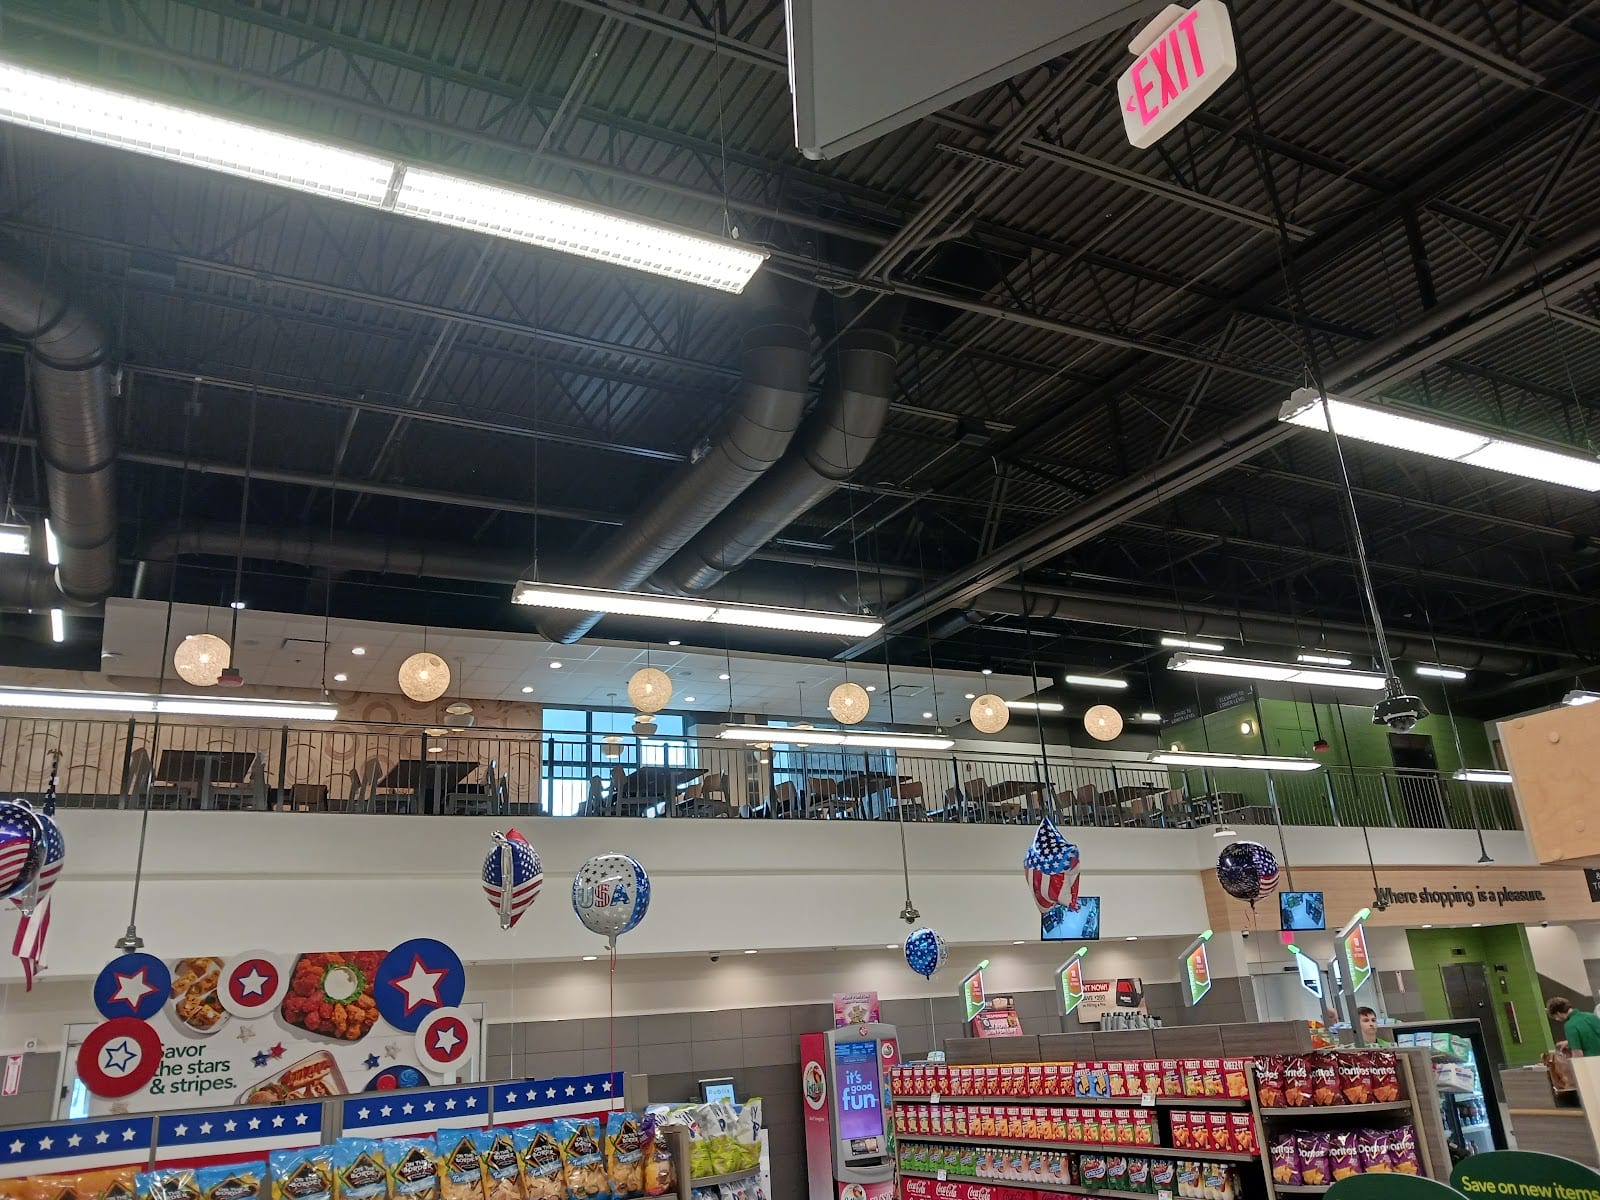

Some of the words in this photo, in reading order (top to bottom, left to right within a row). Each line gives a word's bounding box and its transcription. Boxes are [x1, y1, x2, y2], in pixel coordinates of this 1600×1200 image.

[1130, 9, 1204, 126] EXIT
[578, 884, 630, 909] USA
[1374, 887, 1417, 905] Where
[1418, 886, 1474, 907] shopping
[1476, 886, 1488, 902] is
[1488, 892, 1496, 902] a
[1496, 886, 1546, 906] pleasure.
[187, 1060, 230, 1074] stars
[846, 1070, 862, 1085] it's
[150, 1078, 166, 1095] &
[170, 1076, 237, 1096] stripes.
[851, 1082, 872, 1094] good
[842, 1088, 877, 1111] fun
[1462, 1175, 1496, 1193] Save
[1498, 1183, 1518, 1195] on
[1519, 1184, 1552, 1198] new
